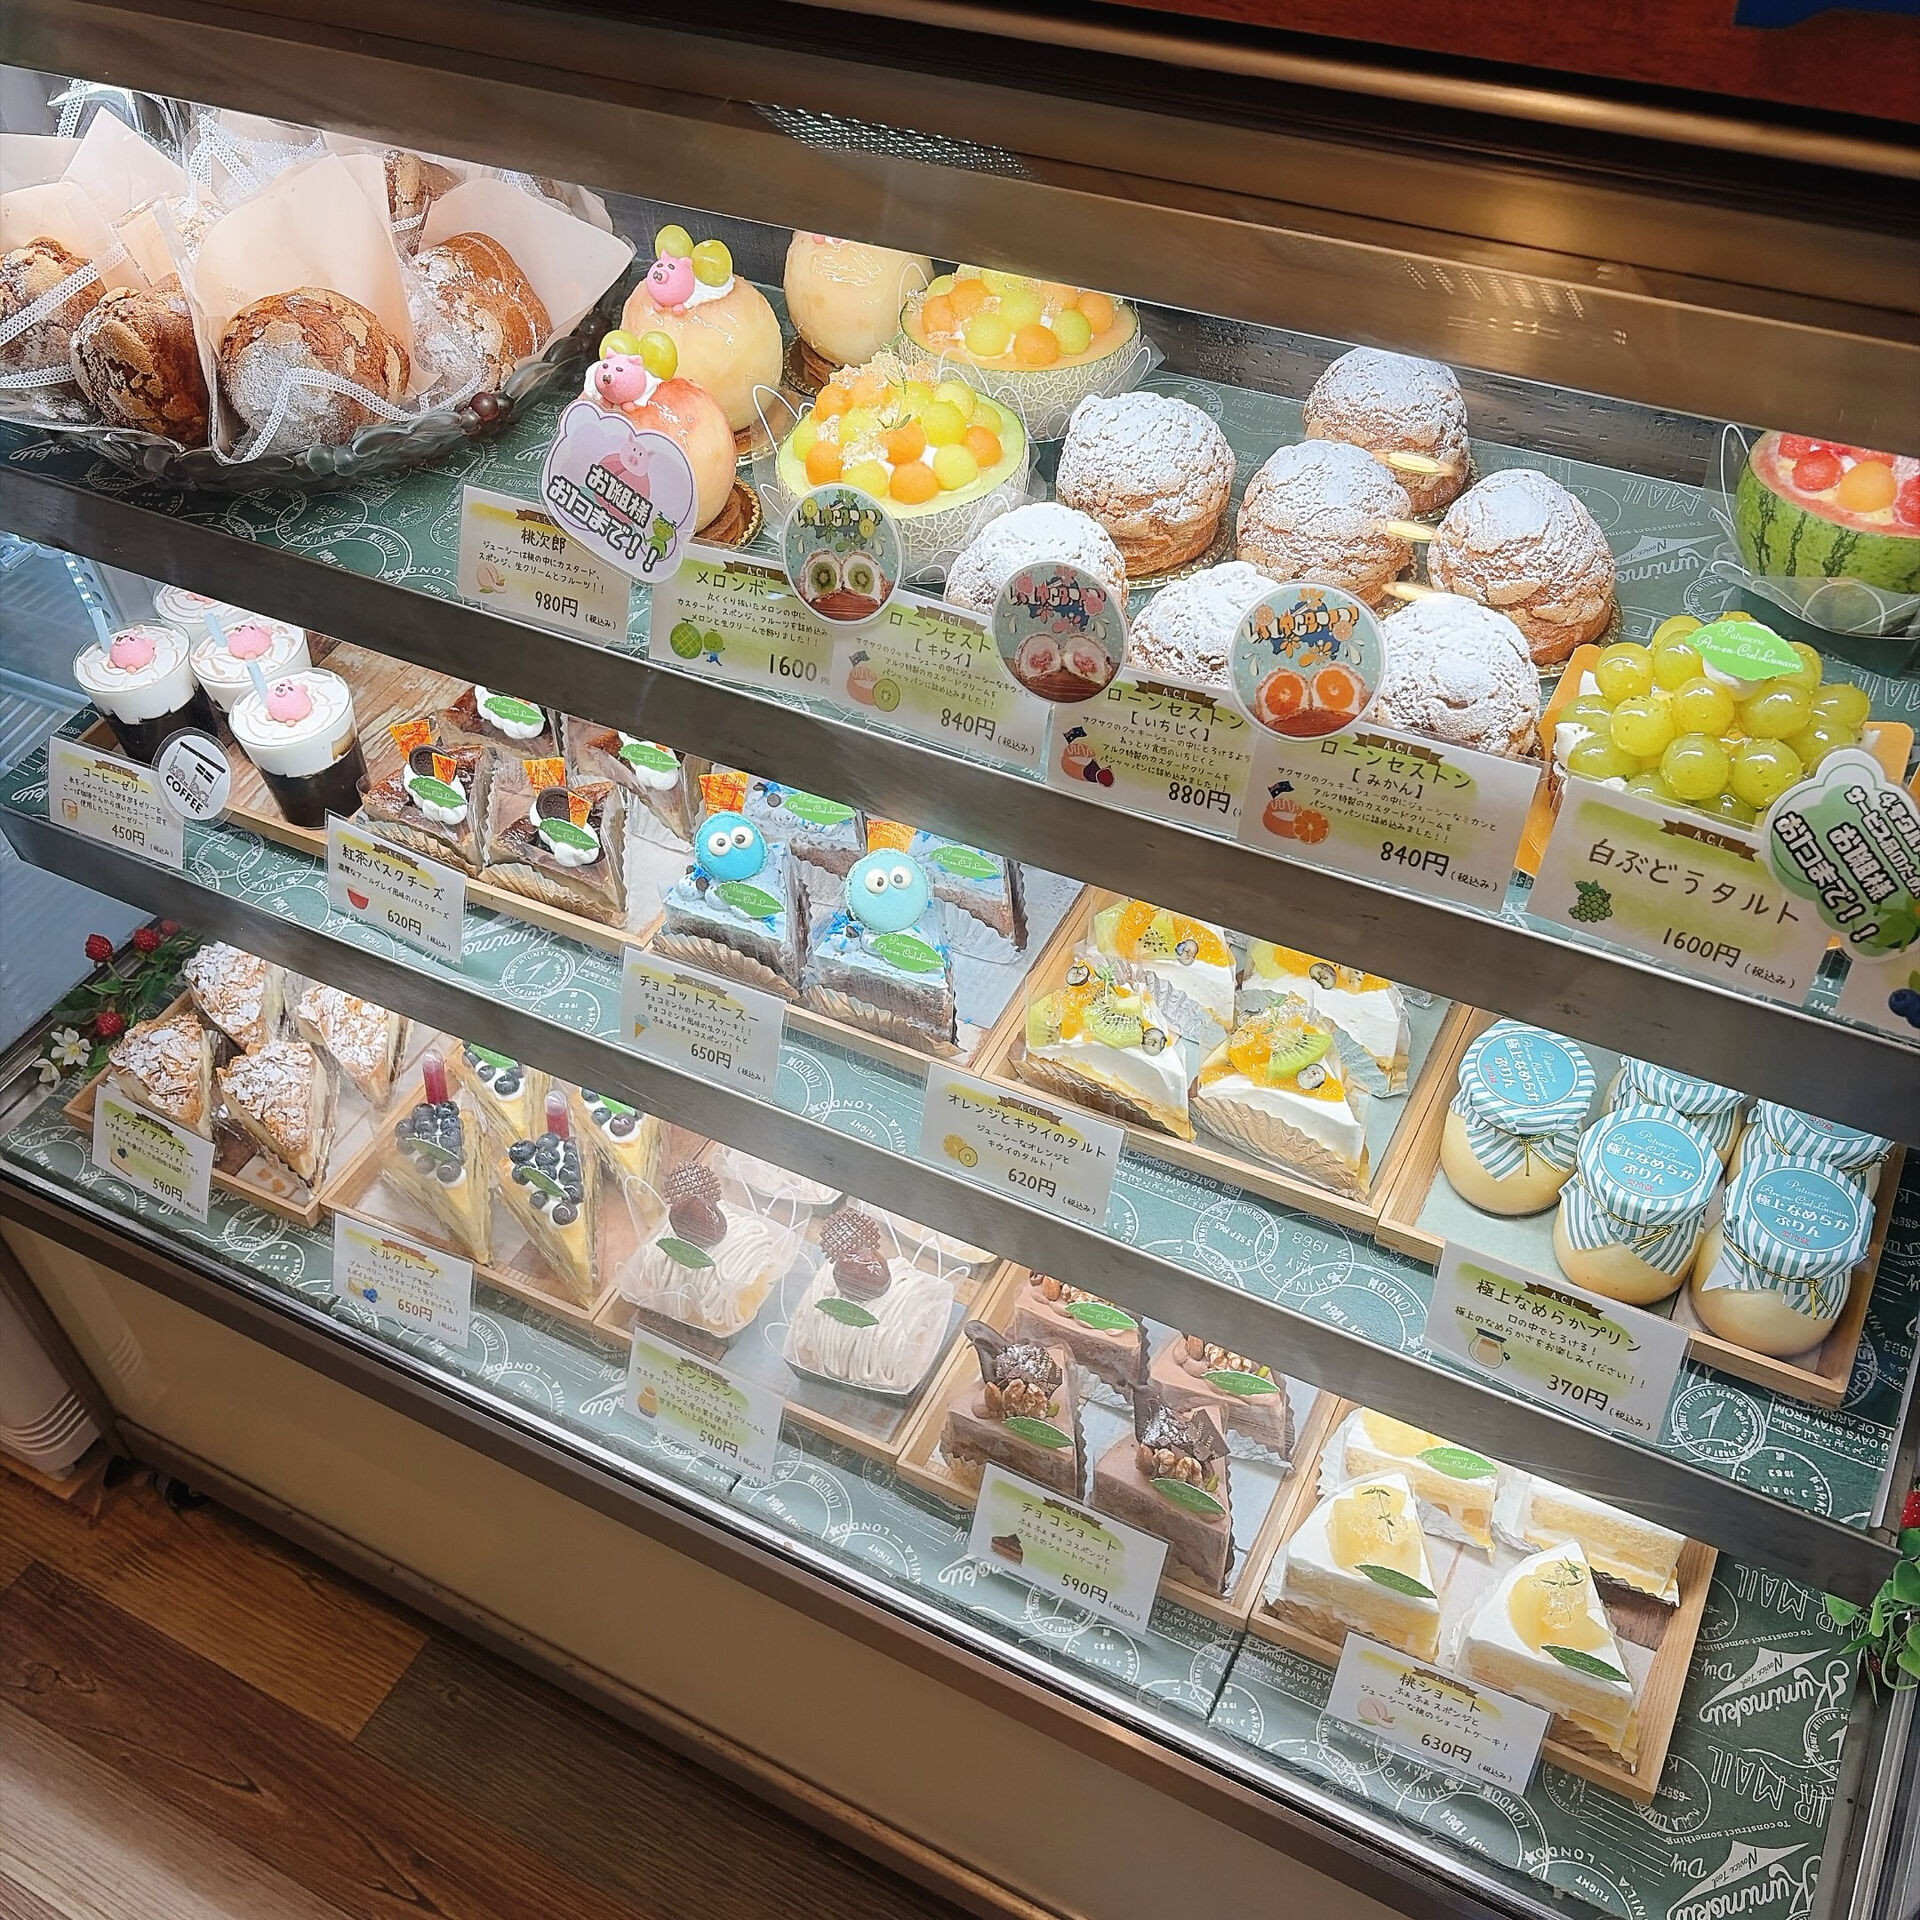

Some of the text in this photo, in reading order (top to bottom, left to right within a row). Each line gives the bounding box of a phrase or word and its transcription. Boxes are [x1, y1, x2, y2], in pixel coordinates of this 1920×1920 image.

[585, 464, 653, 528] お1組様
[521, 527, 567, 554] 桃次郎
[746, 565, 771, 580] A.C.L
[535, 591, 579, 618] 980円
[938, 612, 963, 627] A.C.L
[889, 611, 998, 658] ローンセスト
[1107, 687, 1244, 730] ローンセストン
[1162, 687, 1190, 702] A.C.L
[940, 707, 996, 742] 840円
[1320, 740, 1471, 789] ローンセストン
[1383, 740, 1414, 756] A.C.L
[82, 767, 149, 795] コーヒーゼリー
[165, 775, 204, 815] COFFEE
[1168, 781, 1231, 814] 880円
[111, 824, 145, 847] 450円
[1693, 831, 1725, 849] A.C.L
[342, 843, 446, 901] 紅茶バスクチーズ
[1380, 841, 1449, 877] 840円
[1826, 822, 1899, 904] お1組様
[1588, 837, 1799, 926] 白ぶどうタルト
[387, 909, 422, 937] 620円
[1662, 927, 1742, 968] 1600円
[639, 974, 760, 1023] チョコットスースー
[691, 1043, 732, 1070] 650円
[786, 1056, 823, 1090] LONDON
[1494, 1056, 1516, 1088] ぷりん
[1505, 1038, 1540, 1102] 極上なめらか
[114, 1112, 194, 1159] インディアンサマー
[948, 1094, 1107, 1159] オレンジとキウイのタルト
[976, 1123, 1070, 1165] ジューシーなオレンジと
[987, 1139, 1053, 1171] キウイのタルト！
[1606, 1141, 1694, 1180] 極上なめらか
[152, 1178, 183, 1203] 590円
[1008, 1168, 1057, 1198] 620円
[1621, 1163, 1664, 1185] ぷりん
[1755, 1193, 1849, 1230] 極上なめらか
[1775, 1214, 1821, 1238] ぷりん
[371, 1244, 440, 1279] ミルクレープ
[398, 1299, 432, 1322] 650円
[1367, 1276, 1416, 1318] LONDON
[1549, 1291, 1577, 1309] A.C.L
[1476, 1278, 1642, 1353] 極上なめらかプリン
[1454, 1305, 1646, 1390] 極上のなめらかさをお楽しみください！！
[1507, 1313, 1597, 1356] 口の中でとろける！
[675, 1362, 733, 1396] モンブラン
[1546, 1374, 1609, 1412] 370円
[1772, 1402, 1811, 1425] FROM
[1811, 1417, 1845, 1438] STAY
[699, 1430, 738, 1458] 590円
[1021, 1502, 1118, 1552] チョコショート
[1061, 1573, 1109, 1605] 590円
[1734, 1563, 1809, 1621] MAIL
[1751, 1630, 1799, 1646] construct
[1700, 1658, 1736, 1682] Diy
[1400, 1672, 1482, 1713] 桃ショート
[1421, 1734, 1472, 1764] 630円
[1707, 1745, 1785, 1811] MAIL
[1480, 1783, 1532, 1830] LONDON
[1728, 1823, 1776, 1839] construct
[1669, 1852, 1708, 1879] Diy
